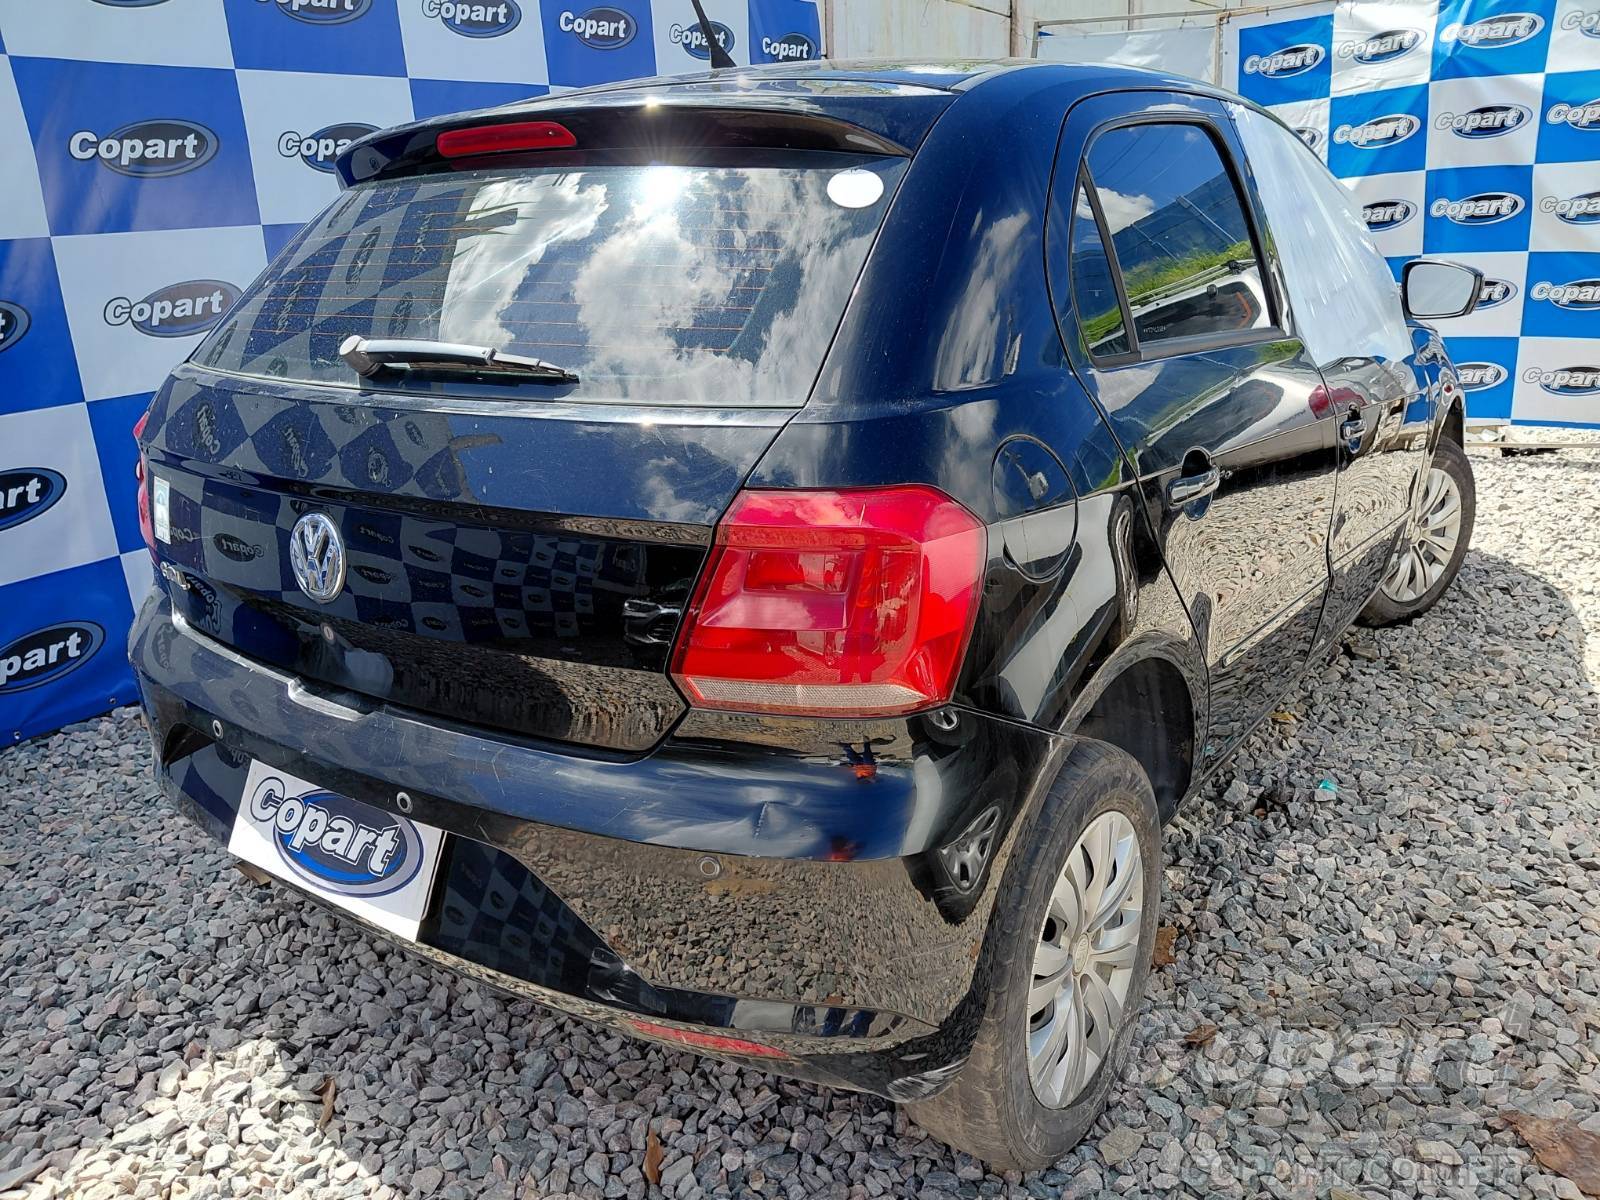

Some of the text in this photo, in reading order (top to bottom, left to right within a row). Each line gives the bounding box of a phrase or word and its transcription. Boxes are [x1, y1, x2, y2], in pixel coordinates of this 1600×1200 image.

[422, 0, 508, 24] Copart
[559, 11, 627, 39] Copart
[669, 23, 726, 49] Copat
[1338, 29, 1414, 61] Copart
[1440, 16, 1532, 47] Copart
[762, 37, 809, 60] Copart
[1243, 48, 1316, 77] Copart
[1333, 115, 1411, 147] Copart
[1434, 107, 1520, 134] Copart
[69, 131, 198, 166] Copart
[1430, 195, 1515, 223] Copart
[103, 288, 224, 326] Copart
[249, 775, 402, 878] Copart
